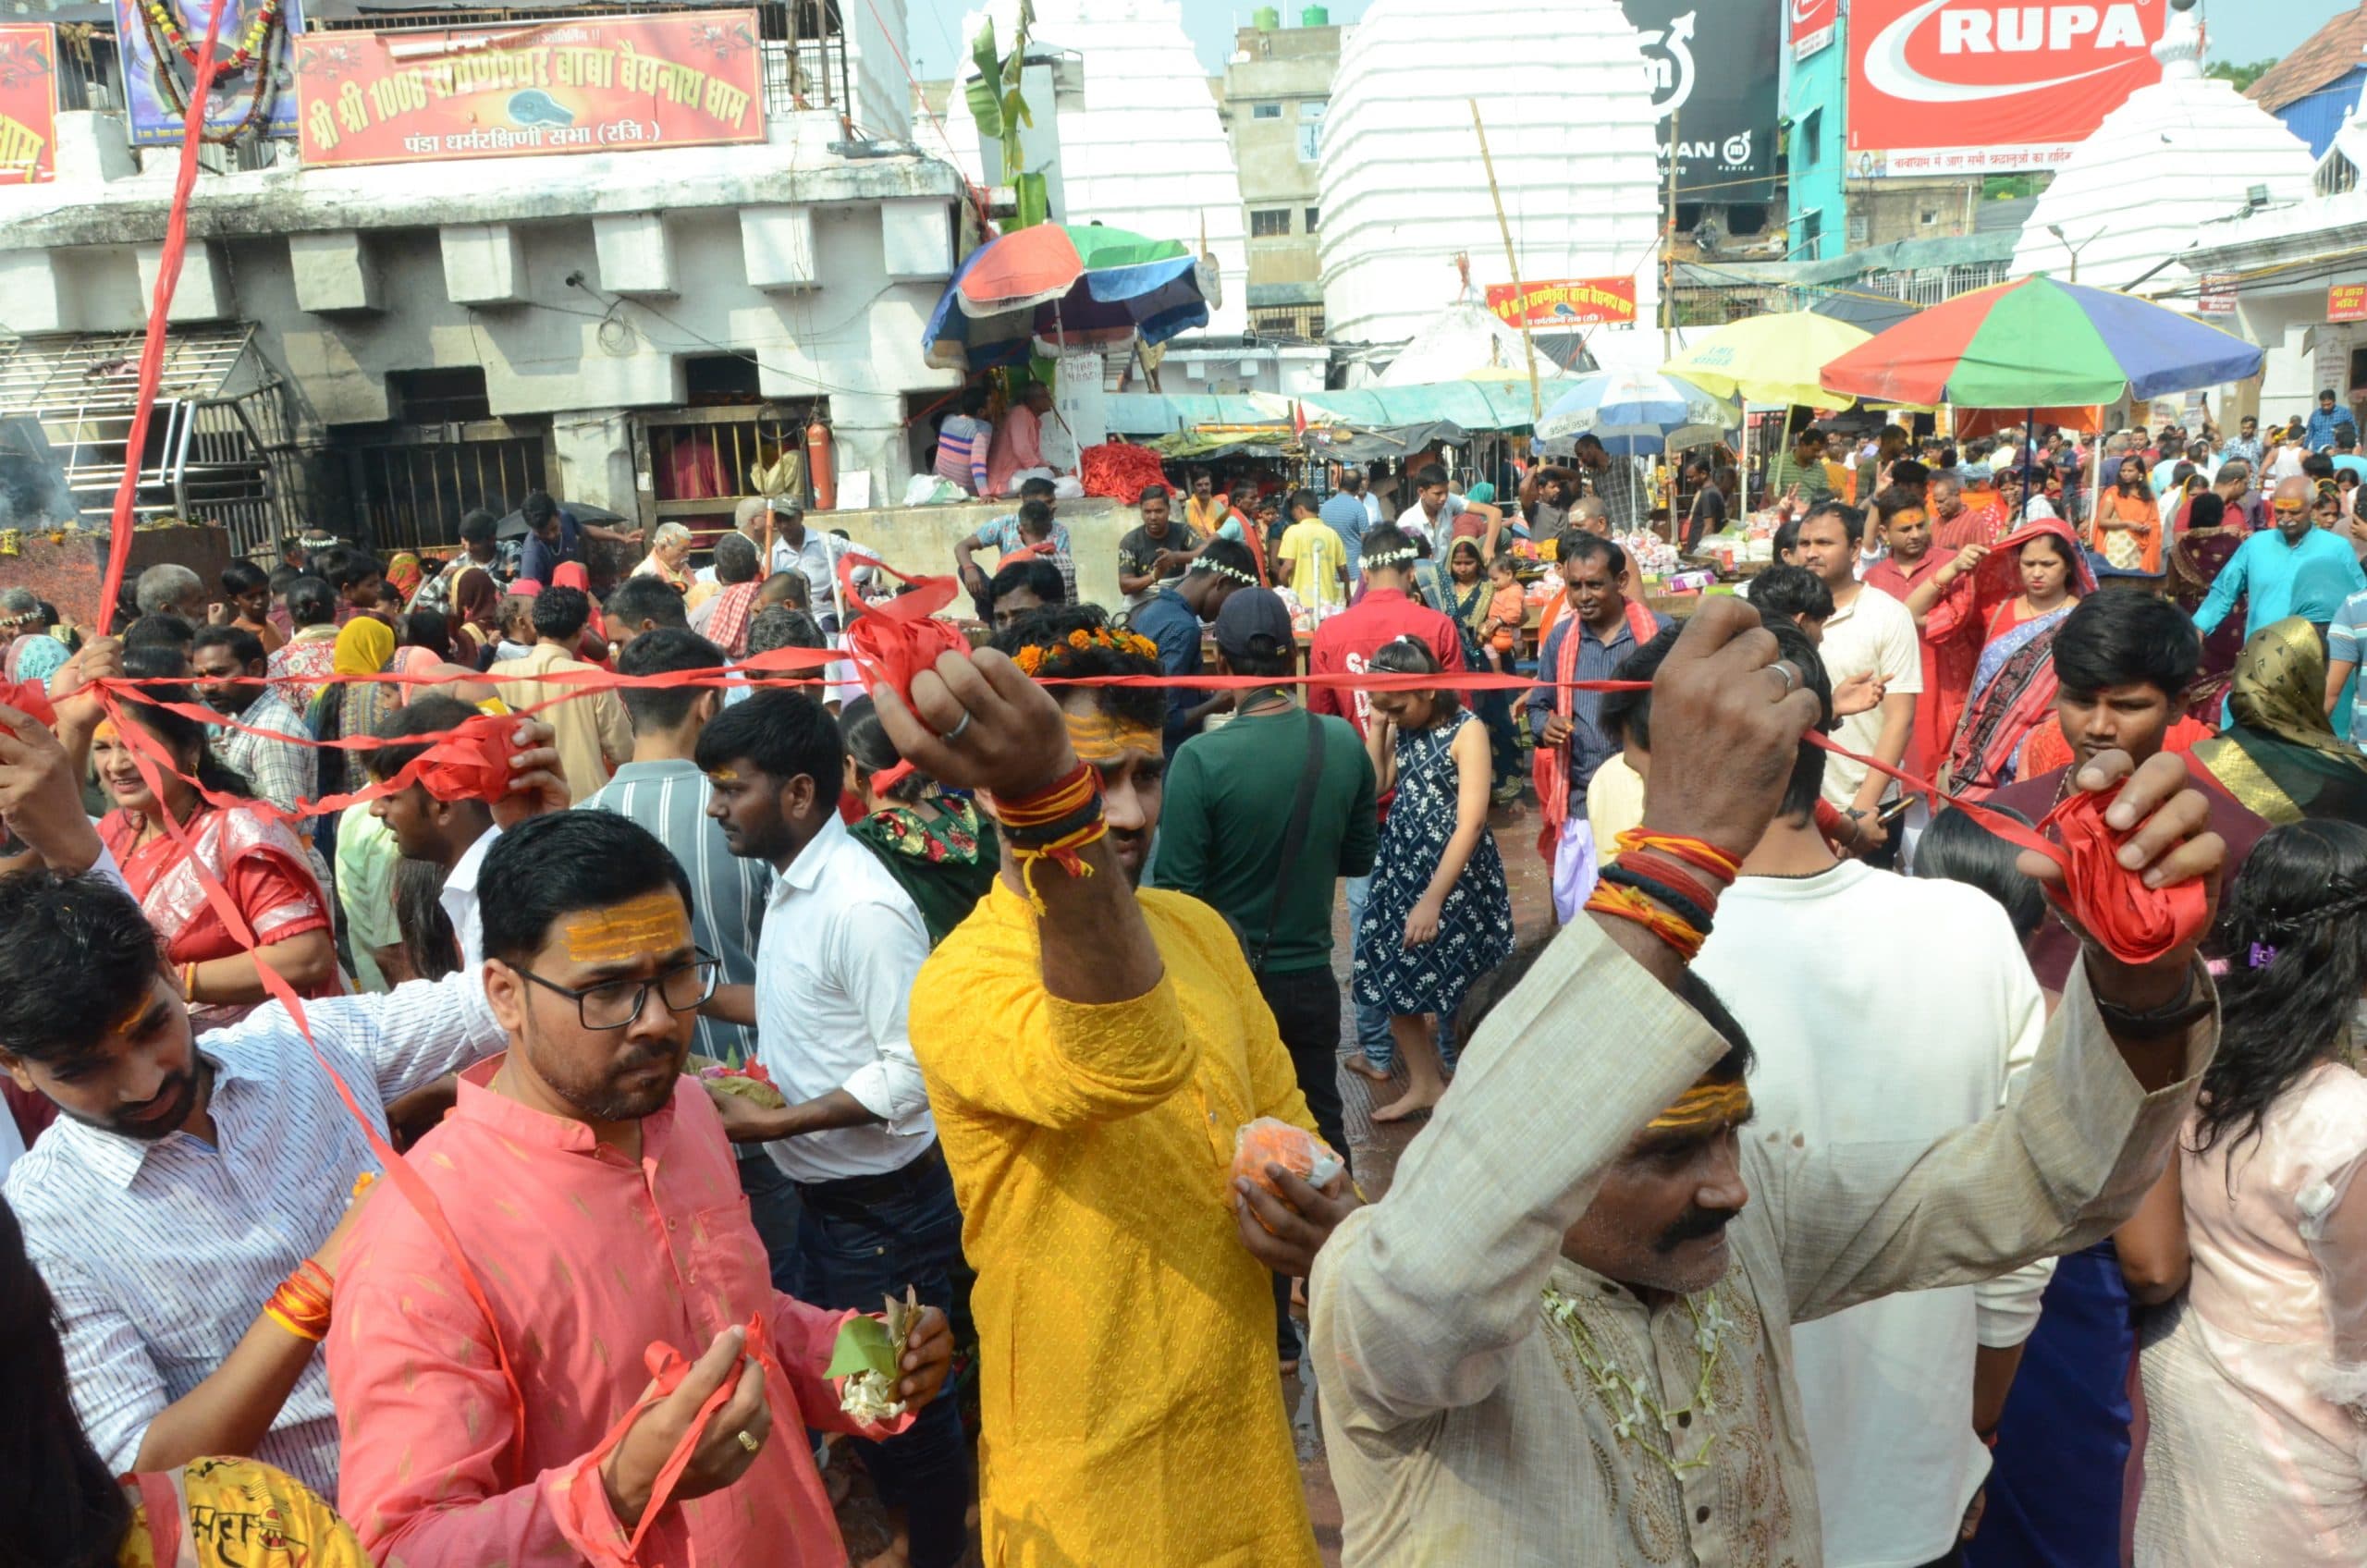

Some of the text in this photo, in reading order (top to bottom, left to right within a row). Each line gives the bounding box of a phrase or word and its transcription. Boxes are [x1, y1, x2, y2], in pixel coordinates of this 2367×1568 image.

[1939, 4, 2146, 55] RUPA
[308, 98, 340, 151] श्री
[337, 80, 370, 134] श्री
[369, 66, 428, 123] 1008
[555, 46, 615, 88] बाबा
[617, 39, 705, 111] बैद्यनाथ
[704, 75, 750, 130] धाम
[403, 132, 440, 153] पंडा
[445, 124, 542, 153] धर्मरक्षिणी
[548, 126, 591, 145] सभा
[1968, 151, 1985, 165] सभी
[2032, 151, 2044, 163] का
